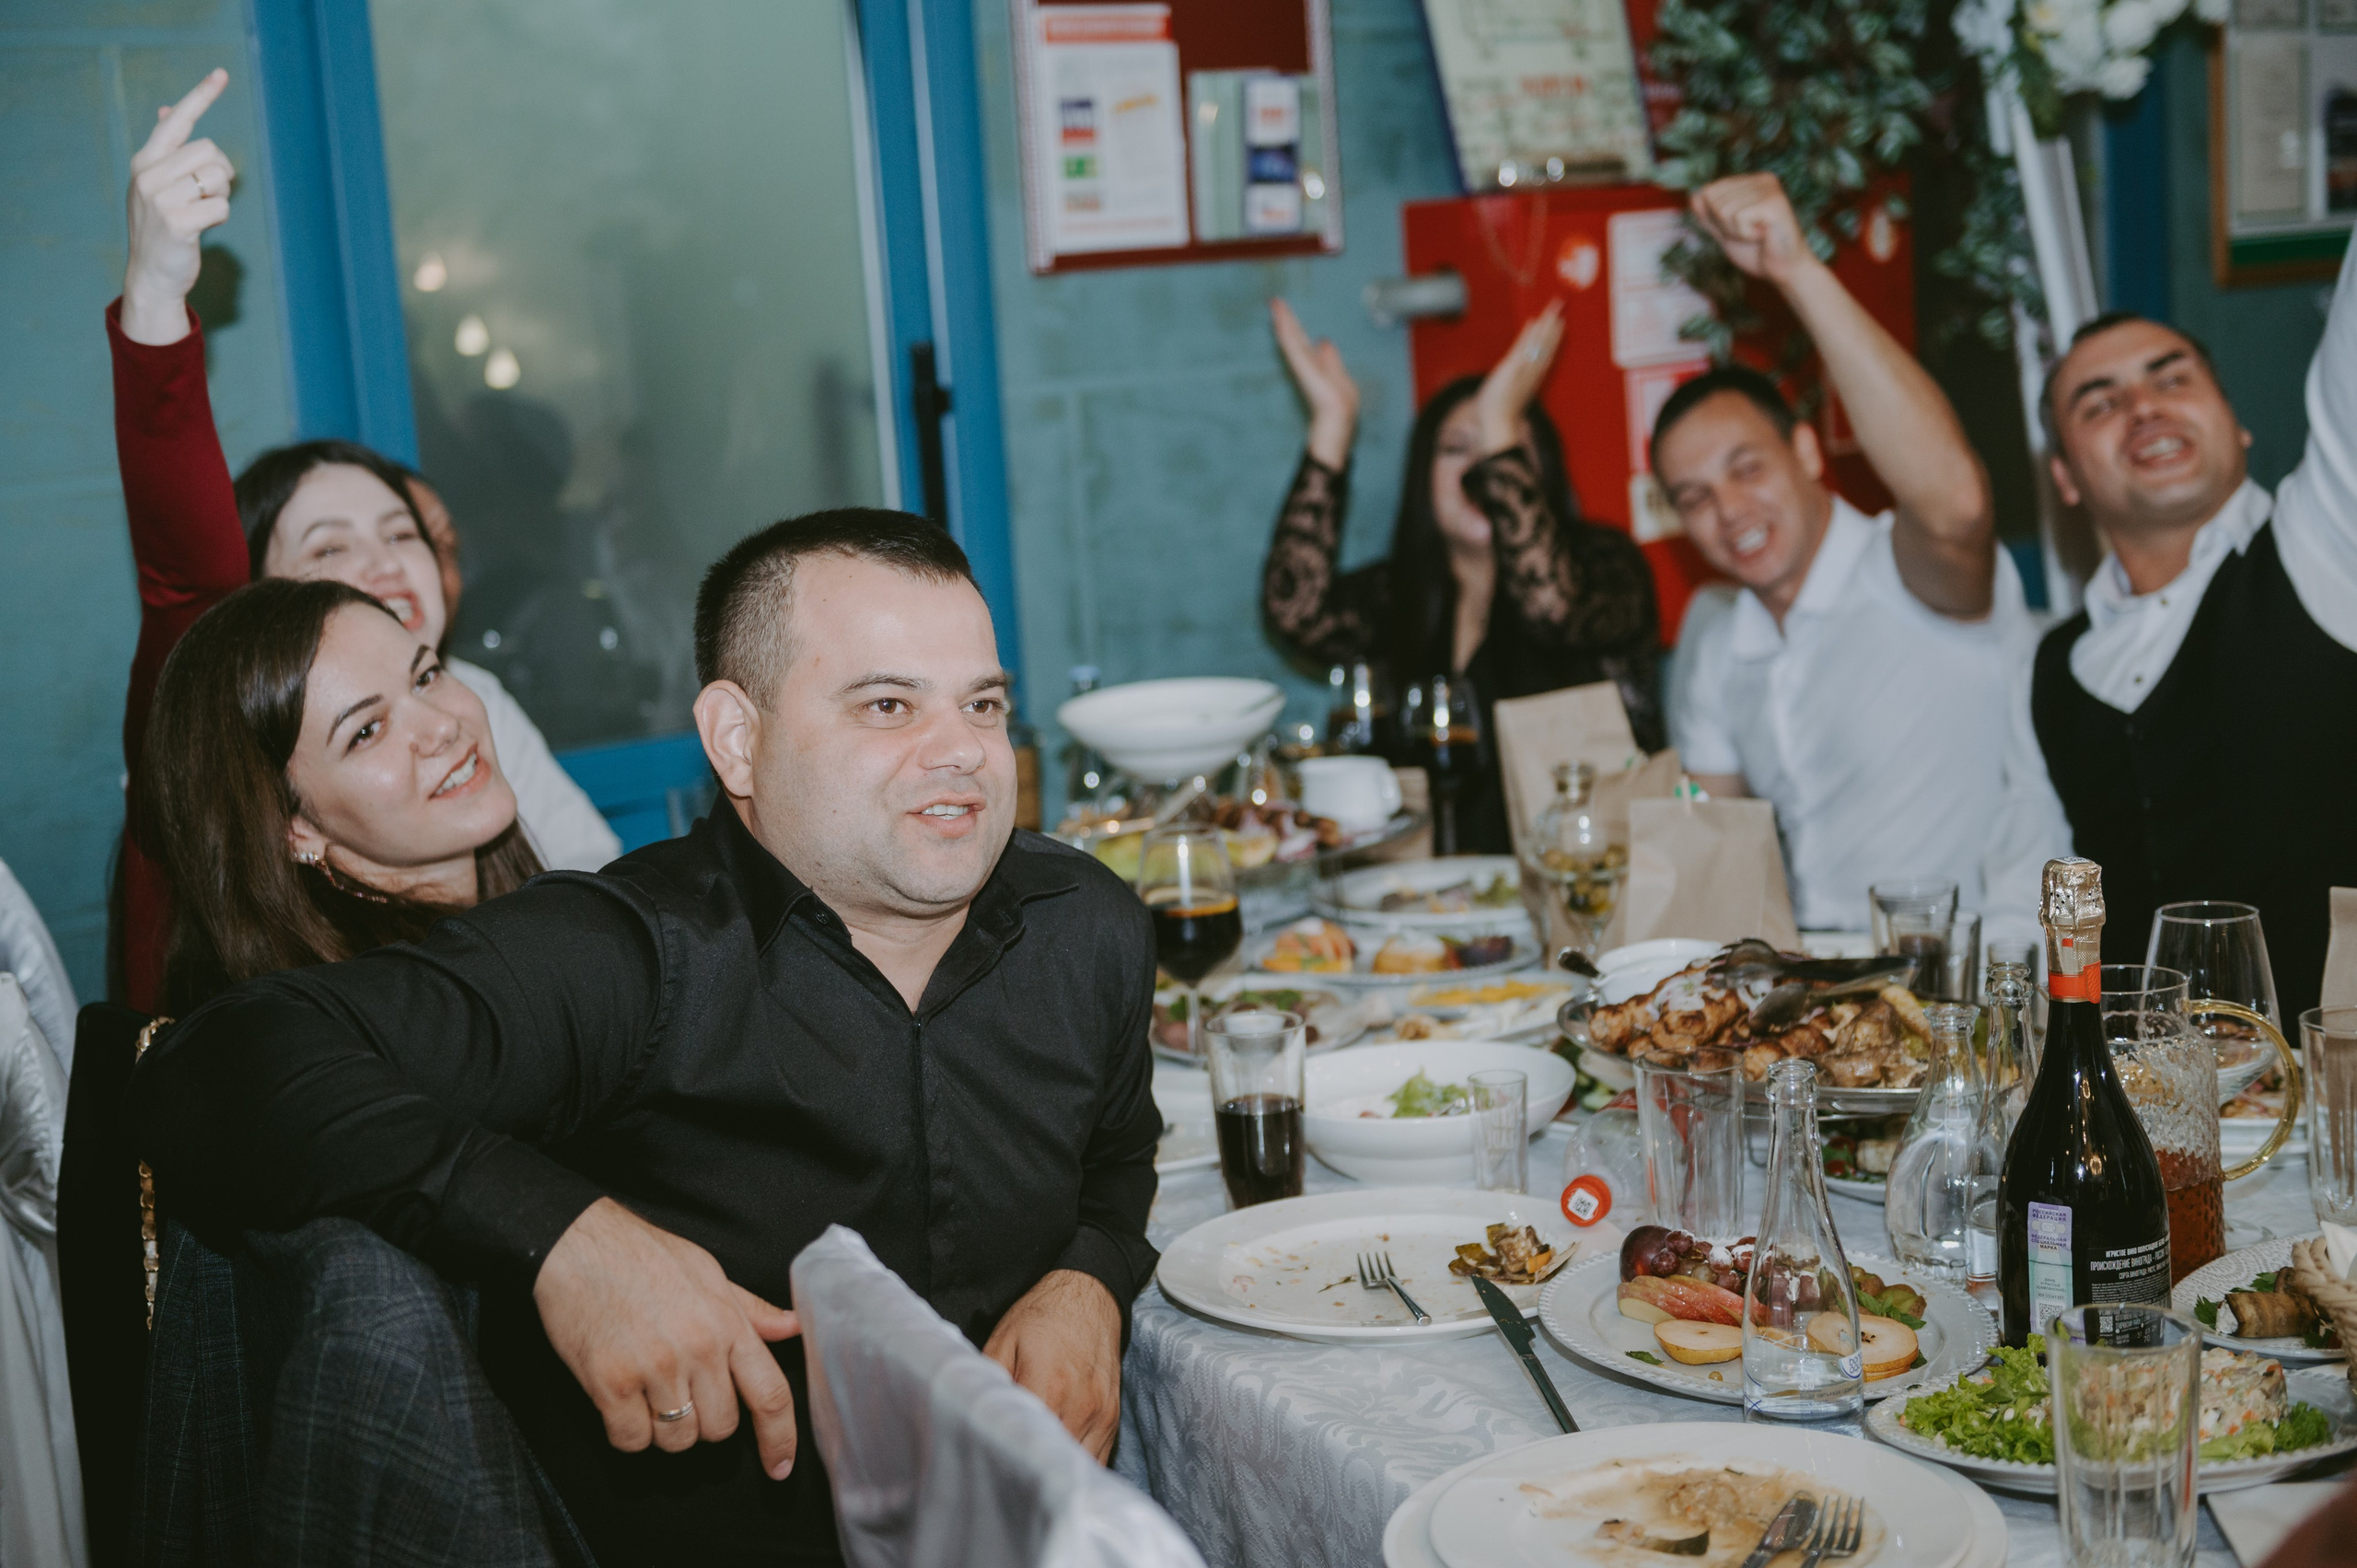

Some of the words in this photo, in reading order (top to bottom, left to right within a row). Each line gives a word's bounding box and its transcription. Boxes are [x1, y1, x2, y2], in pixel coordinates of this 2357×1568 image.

[2032, 1208, 2066, 1217] РОССИЙСКАЯ
[2032, 1213, 2066, 1222] ФЕДЕРАЦИЯ
[2031, 1234, 2067, 1243] ФЕДЕРАЛЬНАЯ
[2031, 1238, 2066, 1248] СПЕЦИАЛЬНАЯ
[2105, 1249, 2127, 1258] ИГРИСТОЕ
[2127, 1247, 2137, 1256] ВИНО
[2090, 1258, 2131, 1272] ПРОИСХОЖДЕНИЕ
[2131, 1253, 2152, 1268] ВИНОГРАДА
[2119, 1272, 2130, 1280] СОРТА
